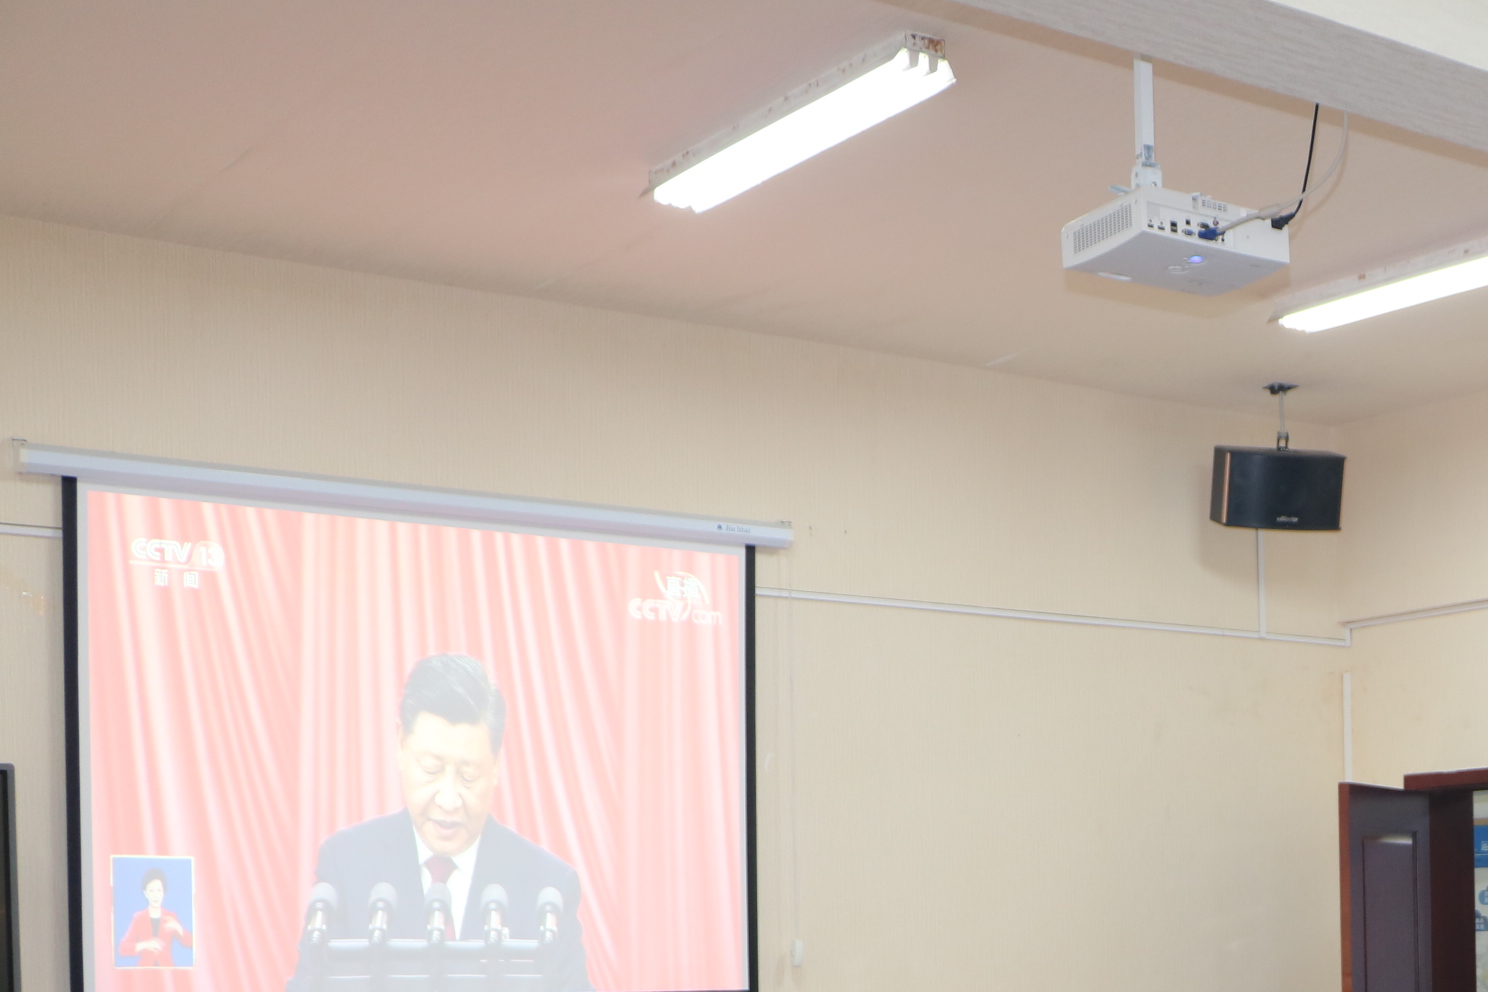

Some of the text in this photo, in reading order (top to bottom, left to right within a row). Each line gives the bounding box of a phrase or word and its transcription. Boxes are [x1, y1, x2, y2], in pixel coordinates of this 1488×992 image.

[131, 537, 192, 562] CCTV
[154, 568, 199, 588] 新闻
[629, 598, 684, 622] CCTV
